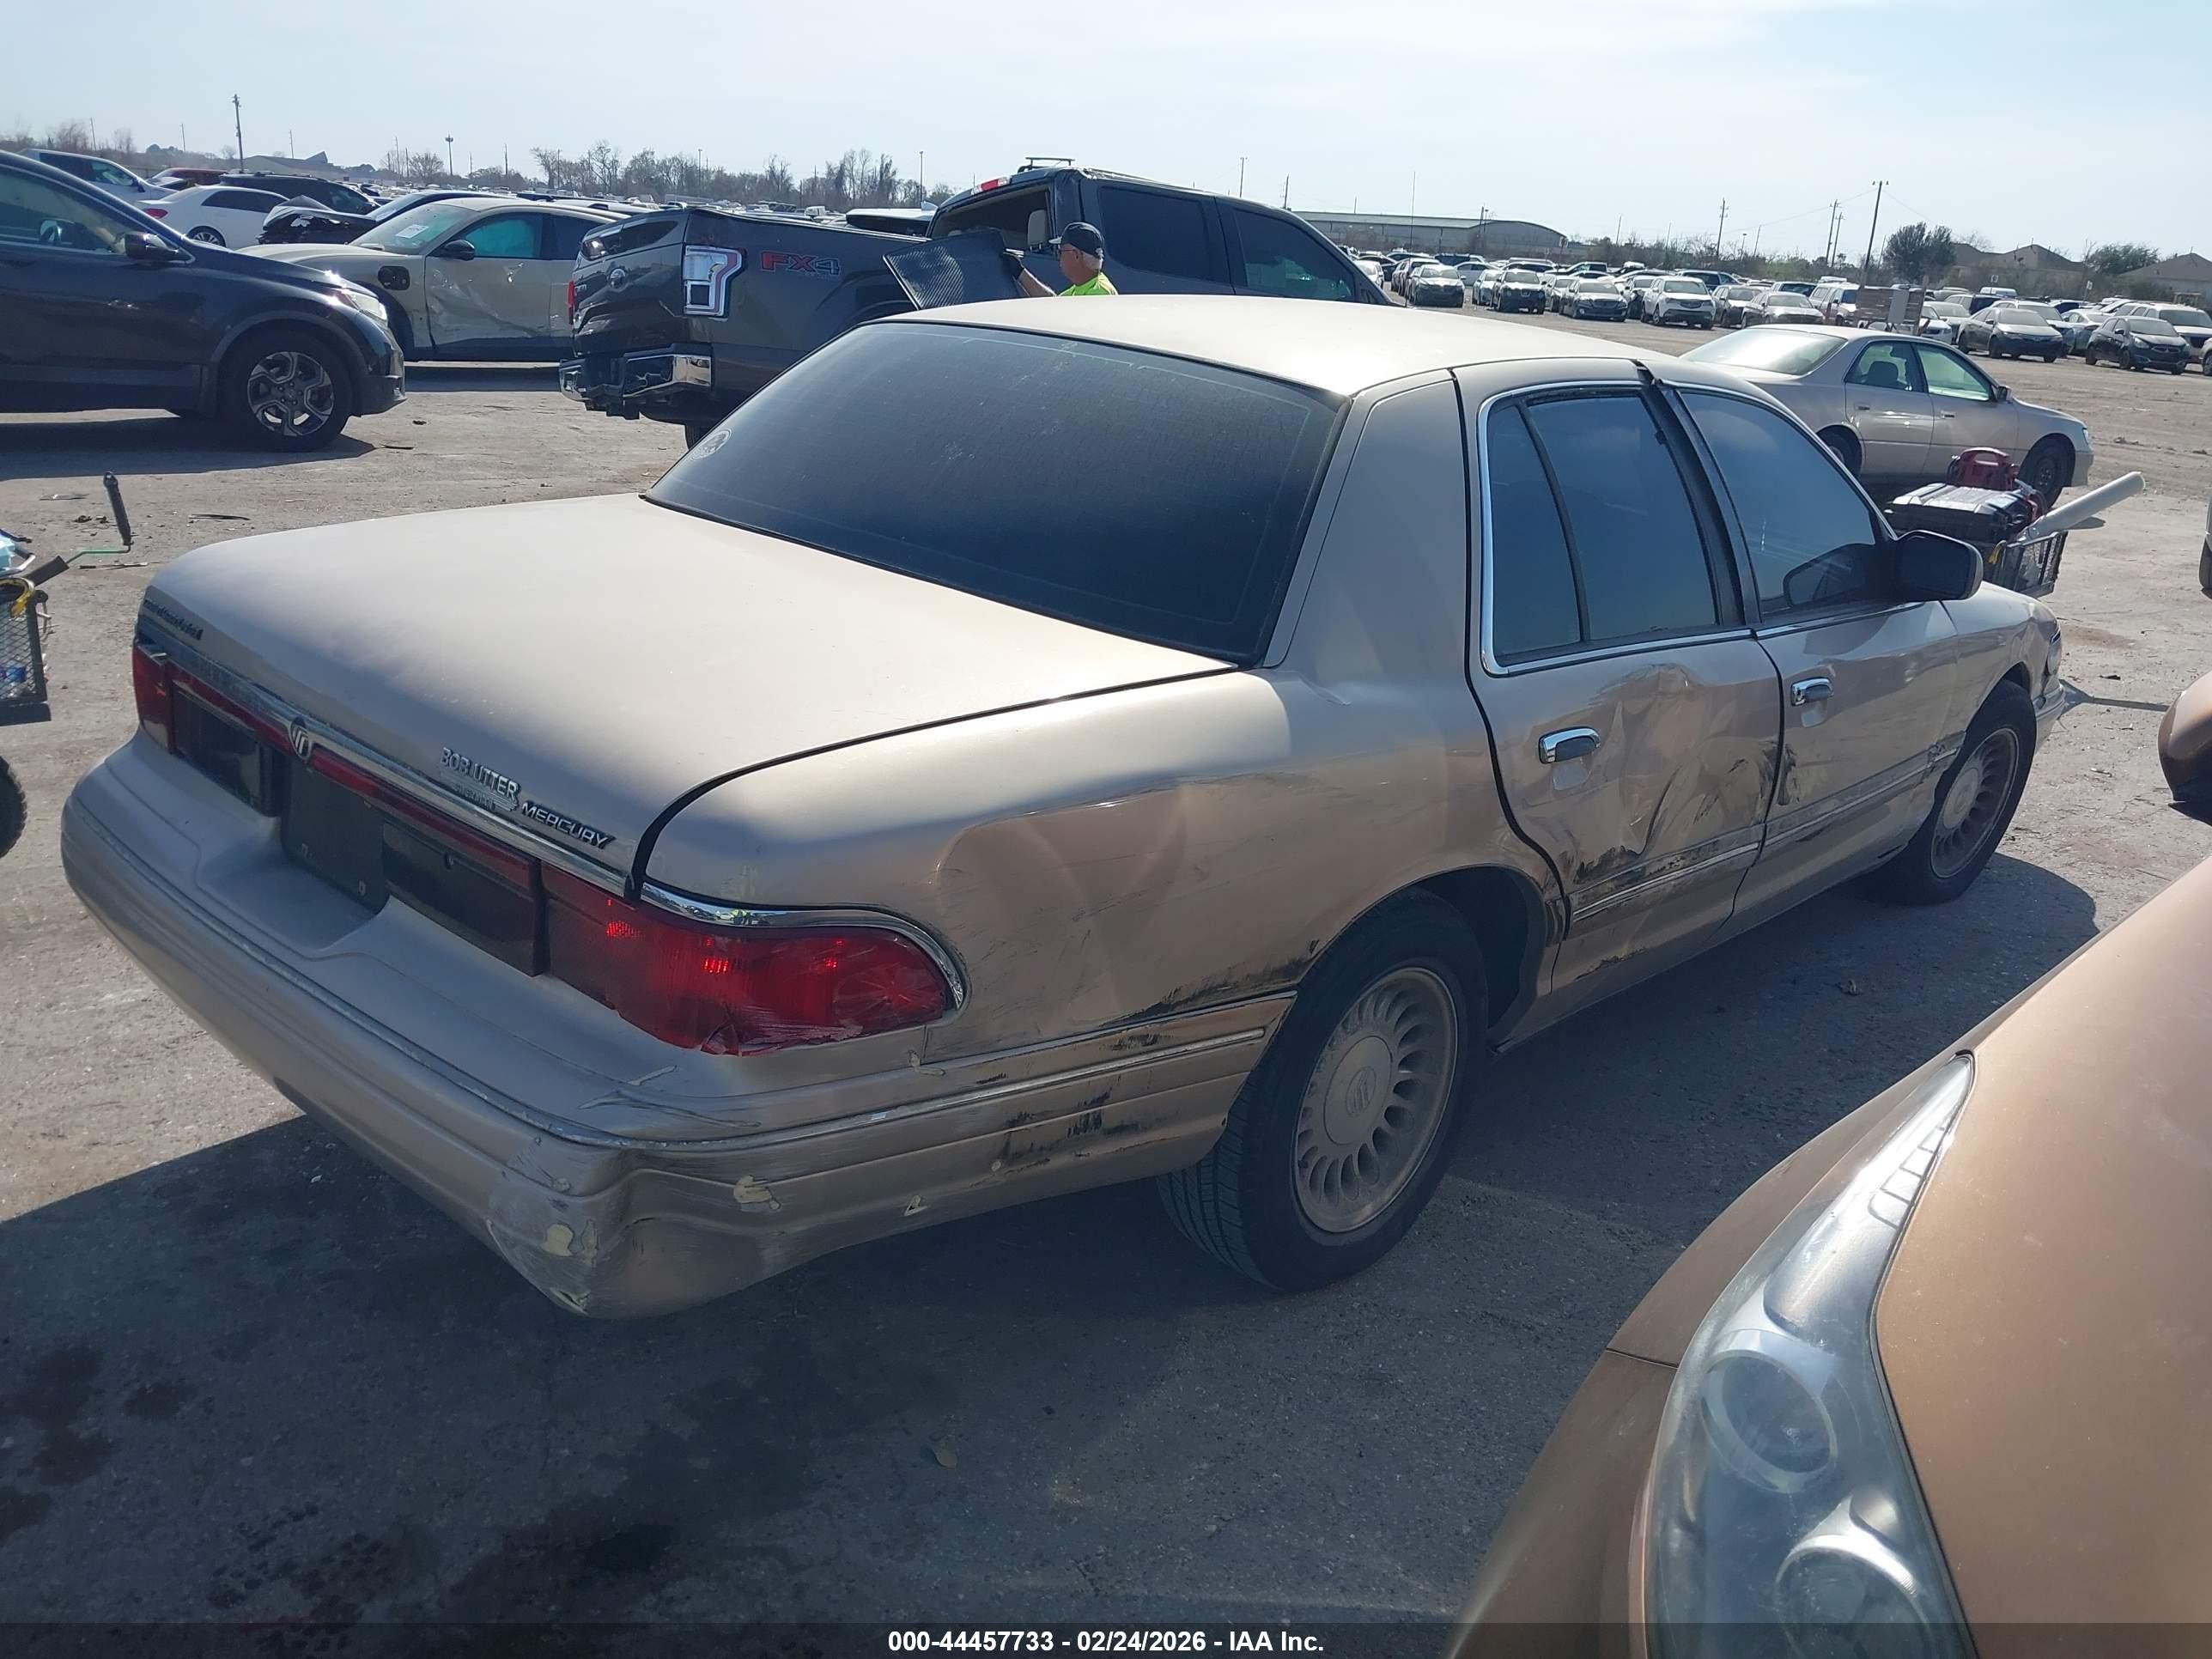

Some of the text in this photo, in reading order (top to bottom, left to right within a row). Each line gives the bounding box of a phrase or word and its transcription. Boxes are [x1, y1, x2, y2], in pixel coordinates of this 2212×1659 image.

[760, 250, 841, 276] FX4
[440, 747, 471, 774] BOB
[472, 763, 520, 801] UTTER
[520, 800, 616, 849] MERCURY
